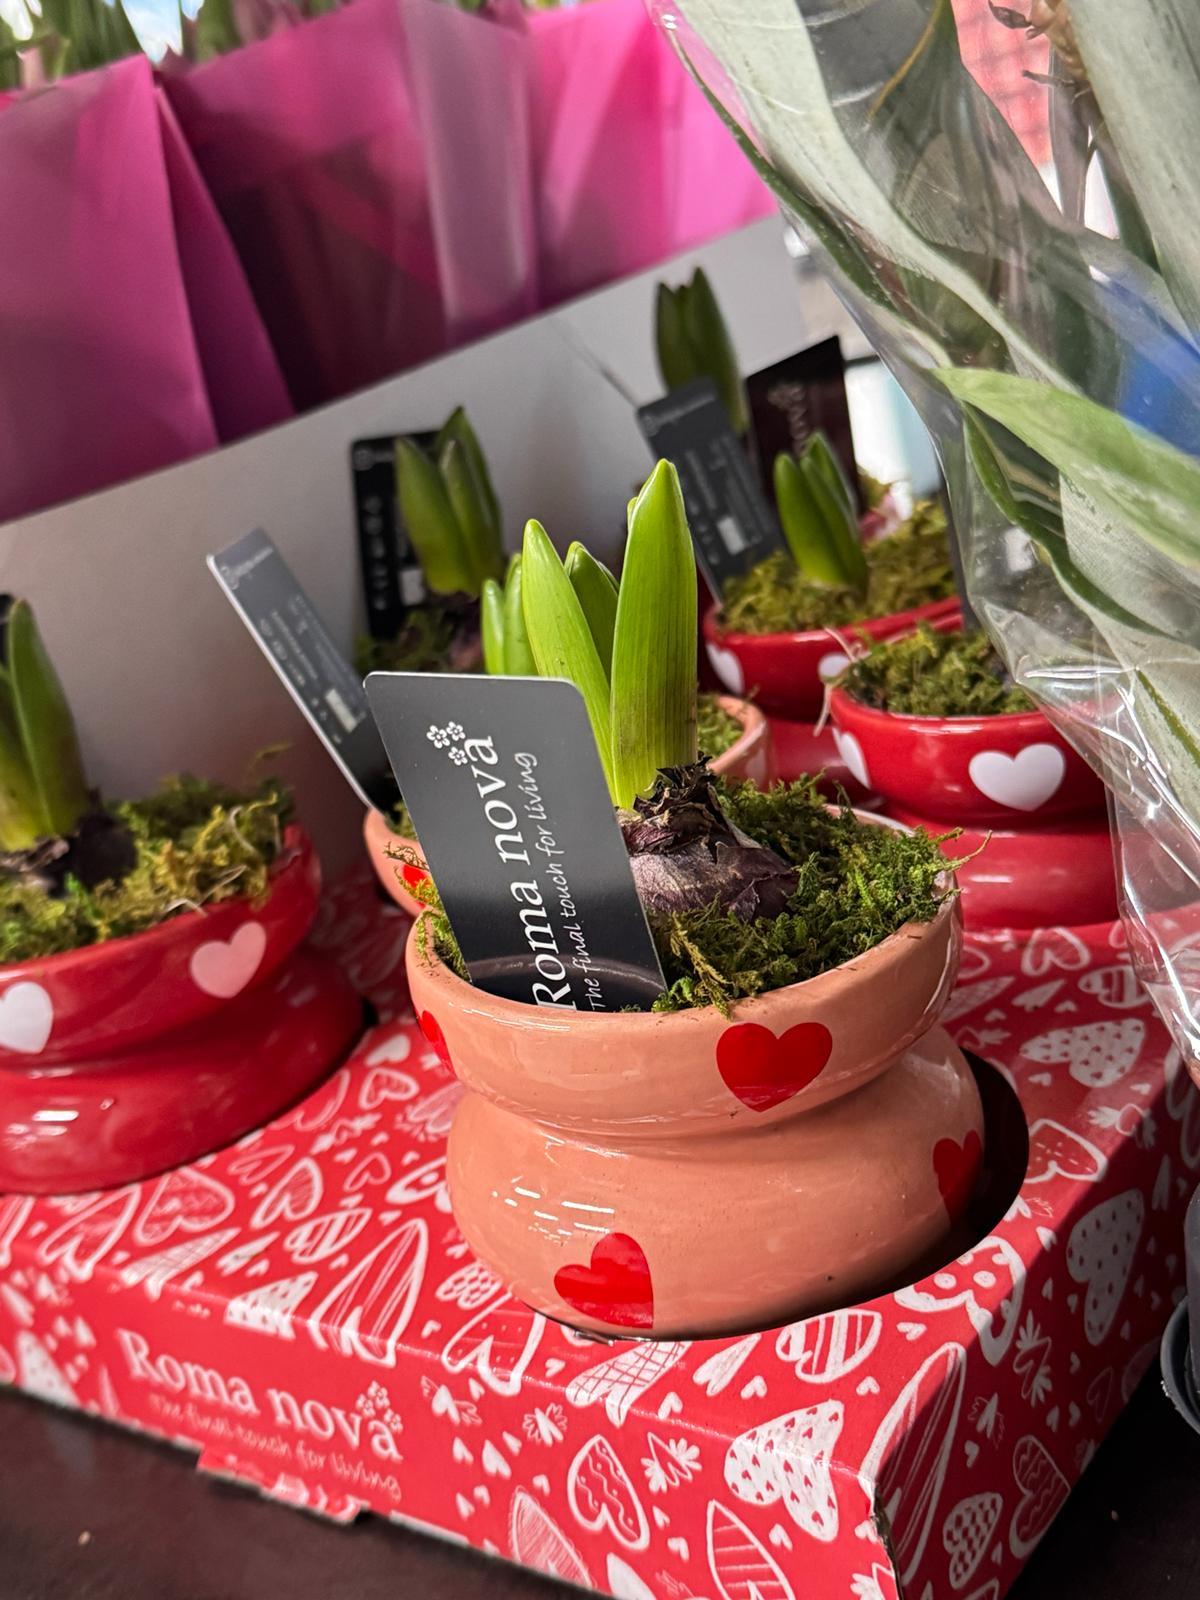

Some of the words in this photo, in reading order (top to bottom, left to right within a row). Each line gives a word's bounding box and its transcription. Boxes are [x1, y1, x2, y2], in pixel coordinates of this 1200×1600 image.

[463, 735, 531, 867] nova
[514, 752, 548, 823] living
[535, 828, 565, 857] for
[545, 864, 577, 917] touch
[511, 879, 577, 1010] Roma
[565, 922, 596, 973] final
[585, 978, 608, 1010] The
[115, 1328, 261, 1417] Roma
[267, 1388, 404, 1462] nova
